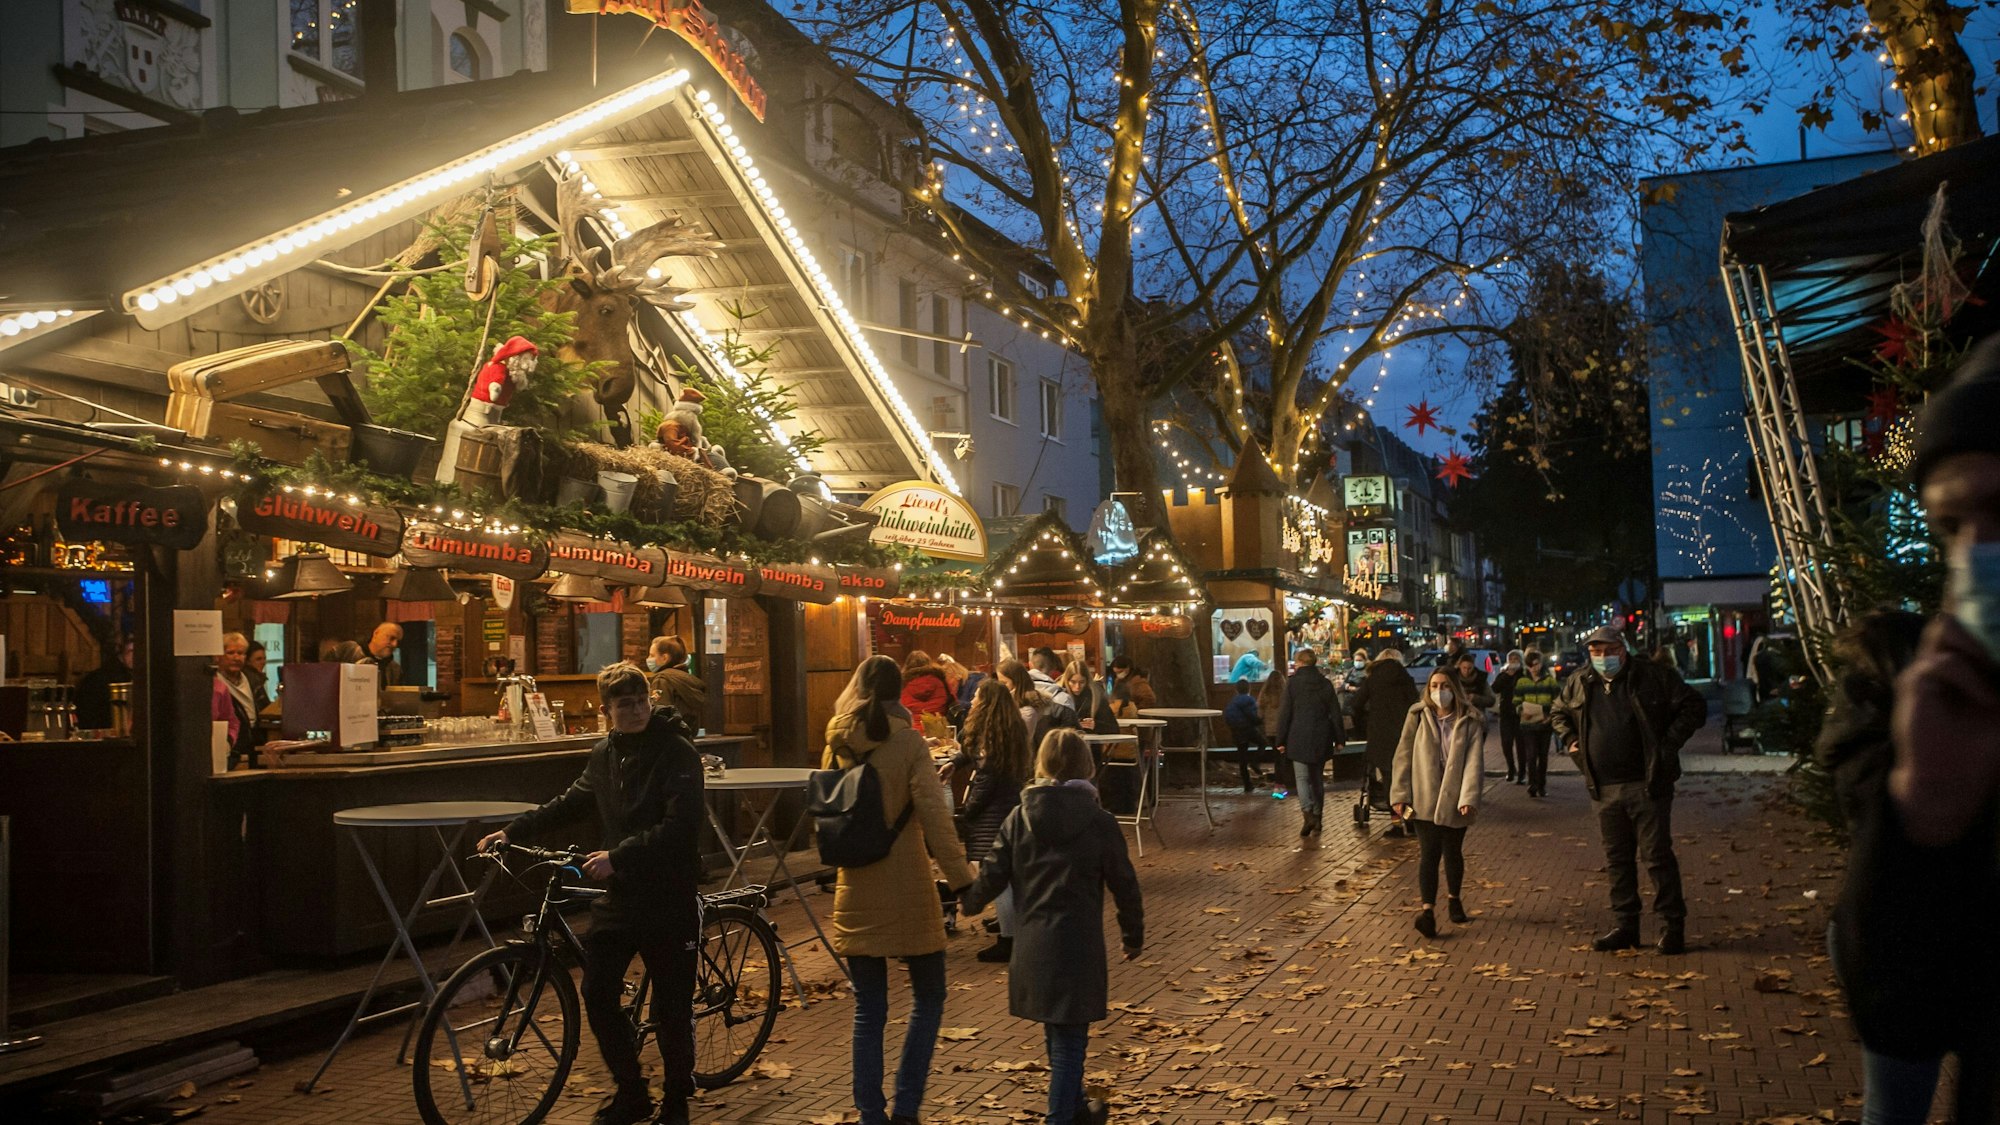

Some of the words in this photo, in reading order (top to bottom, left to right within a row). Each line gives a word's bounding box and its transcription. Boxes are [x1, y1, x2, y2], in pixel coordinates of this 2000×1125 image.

[70, 497, 180, 528] Kaffee
[899, 492, 948, 516] Liesel's
[254, 494, 380, 540] Glühwein
[412, 531, 533, 564] Lumumba
[928, 539, 955, 549] Jahren
[667, 559, 745, 585] lühwein
[761, 567, 825, 592] mumba
[841, 573, 886, 589] akao
[882, 610, 961, 630] Dampfnudeln
